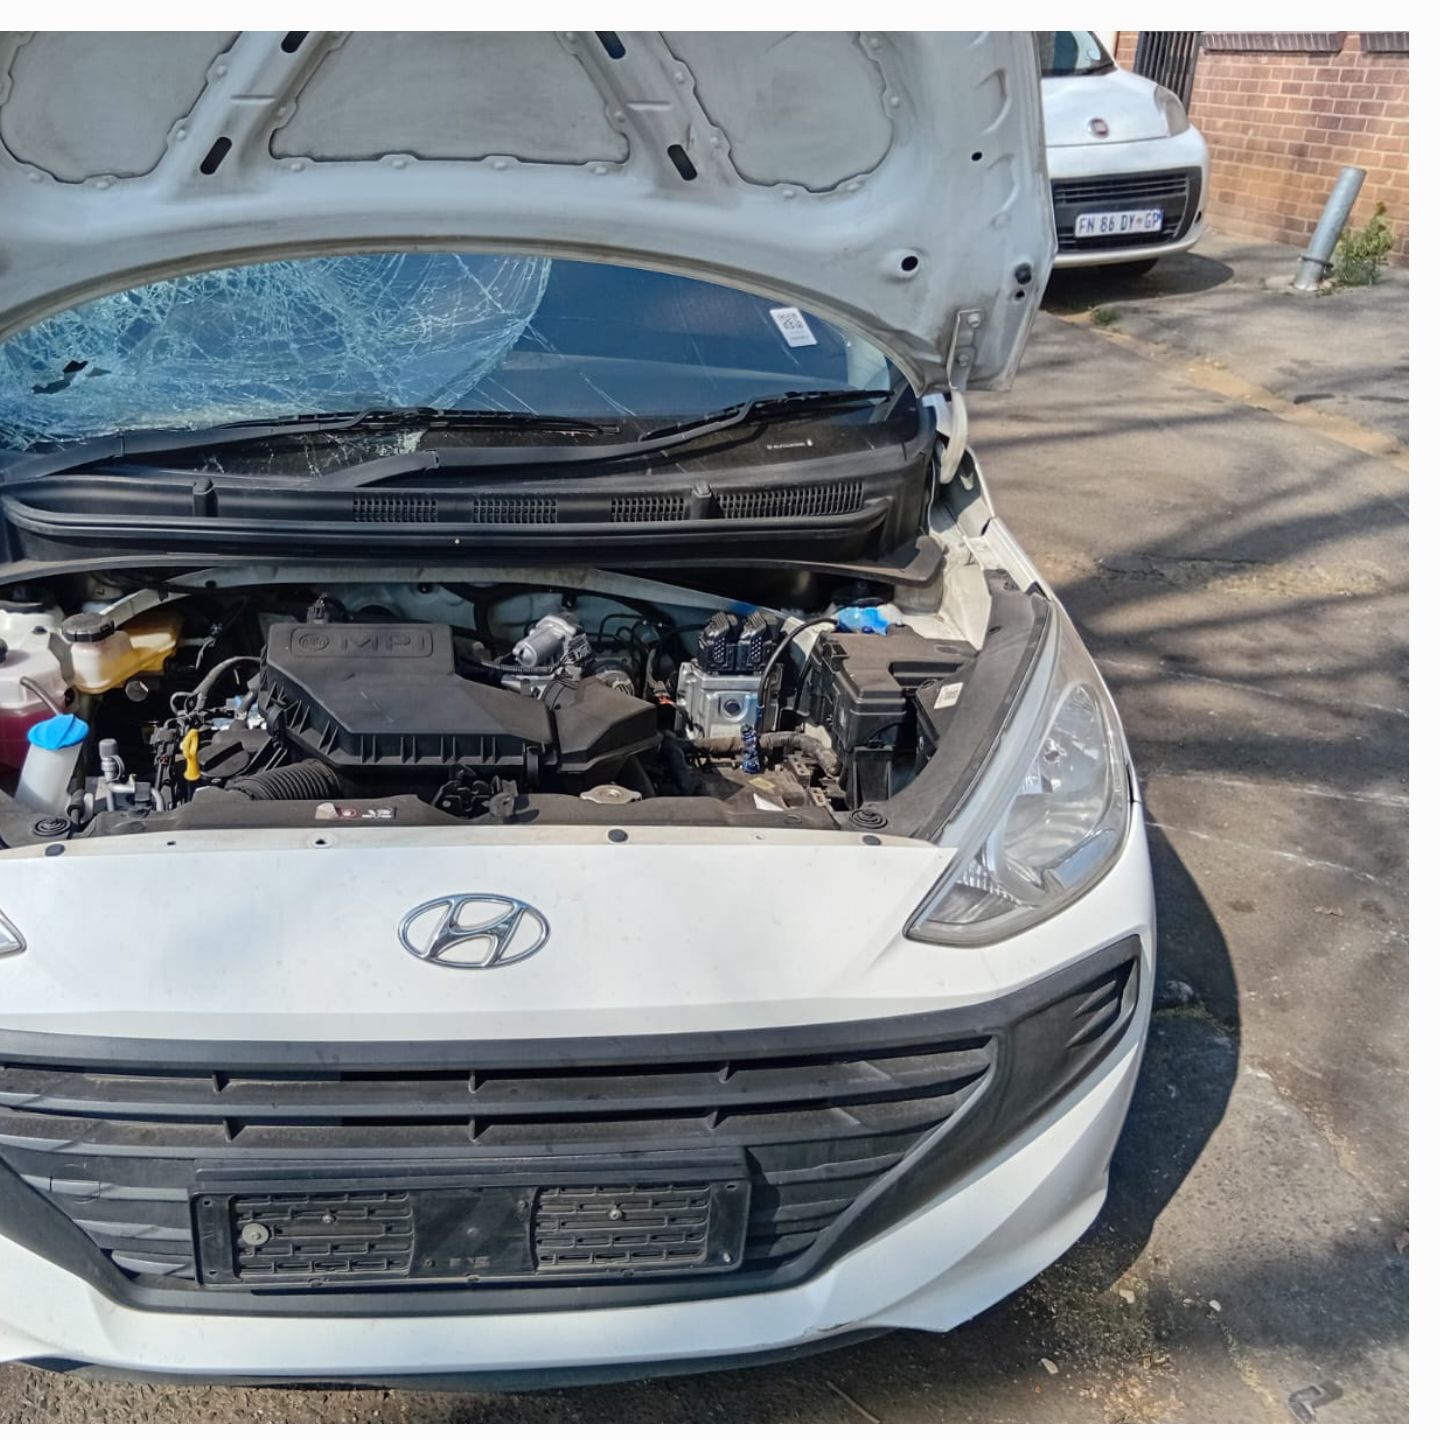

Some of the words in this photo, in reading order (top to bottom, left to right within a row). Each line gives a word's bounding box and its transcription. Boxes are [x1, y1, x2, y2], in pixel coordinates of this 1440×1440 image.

[1079, 217, 1095, 233] FN
[1100, 216, 1115, 232] 86
[1120, 214, 1135, 231] DY
[1144, 211, 1160, 229] GP
[340, 634, 426, 651] MPI
